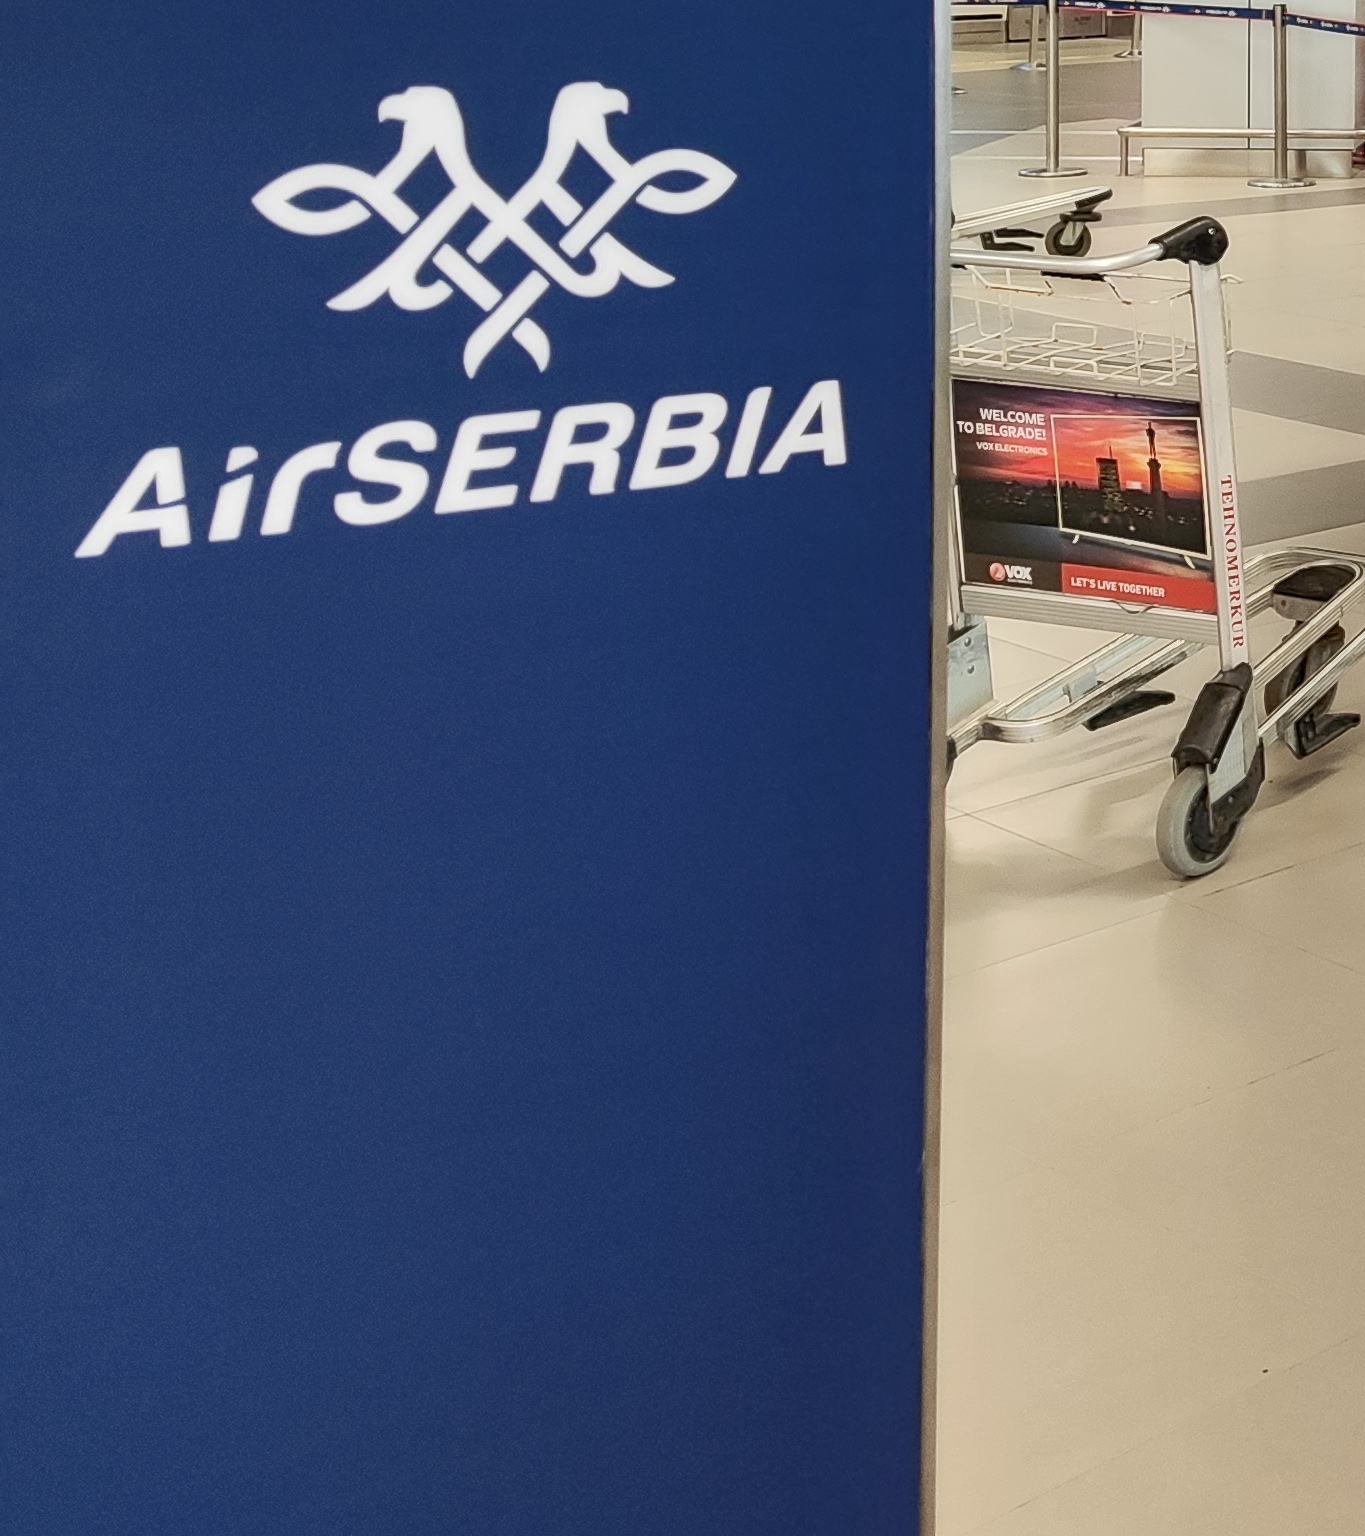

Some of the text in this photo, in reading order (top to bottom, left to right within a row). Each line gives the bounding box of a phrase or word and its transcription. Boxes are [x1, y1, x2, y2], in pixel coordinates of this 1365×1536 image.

[979, 407, 1046, 426] WELCOME
[956, 420, 1047, 441] TO BELGRADE!
[976, 441, 1049, 456] VOX ELECTRONICS
[1220, 474, 1245, 649] TEHNOMERKUR
[1004, 564, 1033, 581] VOX
[1070, 576, 1166, 599] LET'S LIVE TOGETHER
